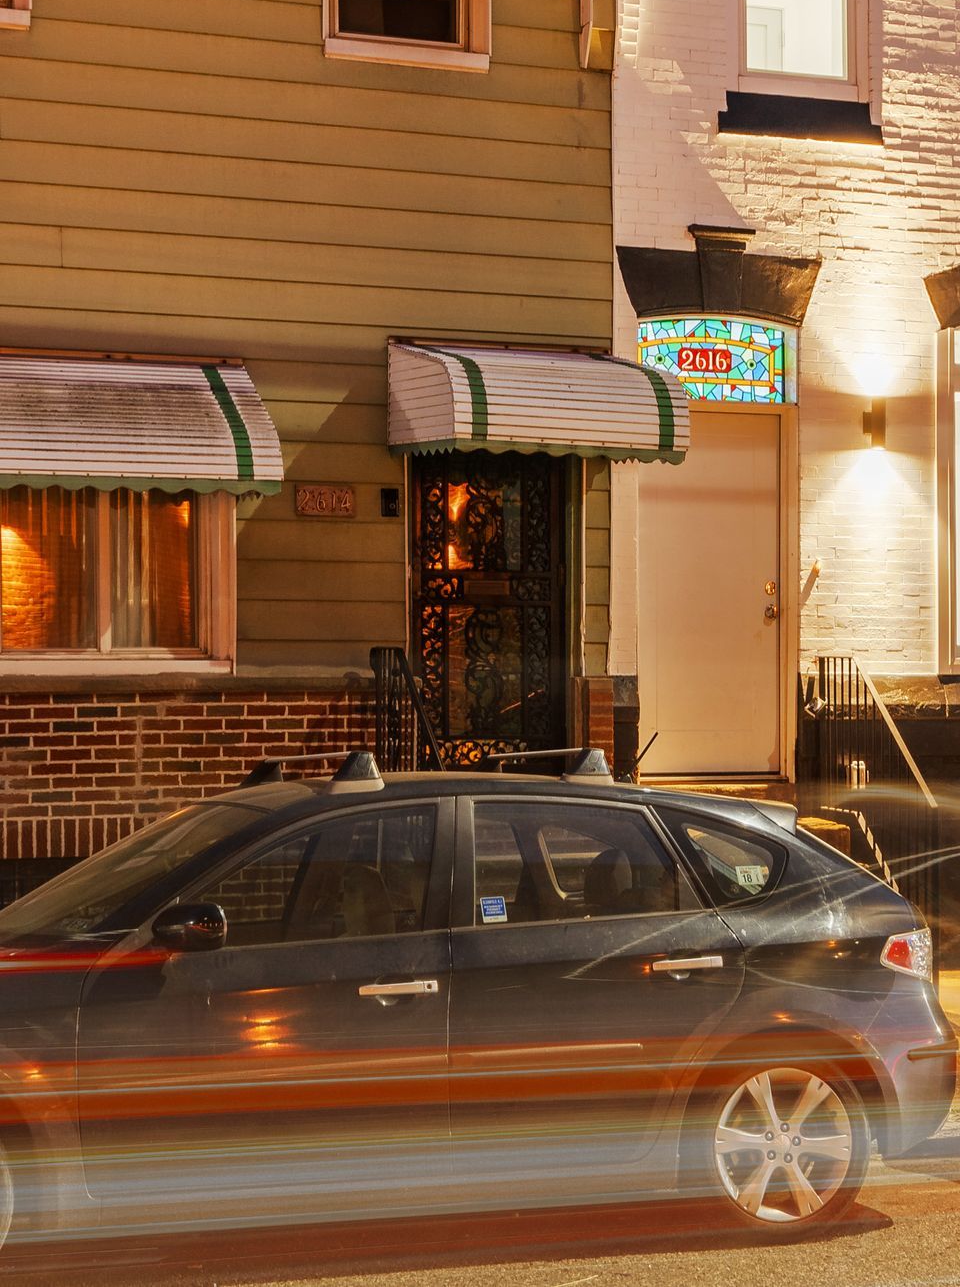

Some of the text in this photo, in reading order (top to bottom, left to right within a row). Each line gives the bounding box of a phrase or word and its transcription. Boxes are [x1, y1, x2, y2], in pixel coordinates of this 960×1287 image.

[681, 350, 727, 370] 2616
[297, 489, 351, 512] 2614
[743, 874, 752, 883] 18
